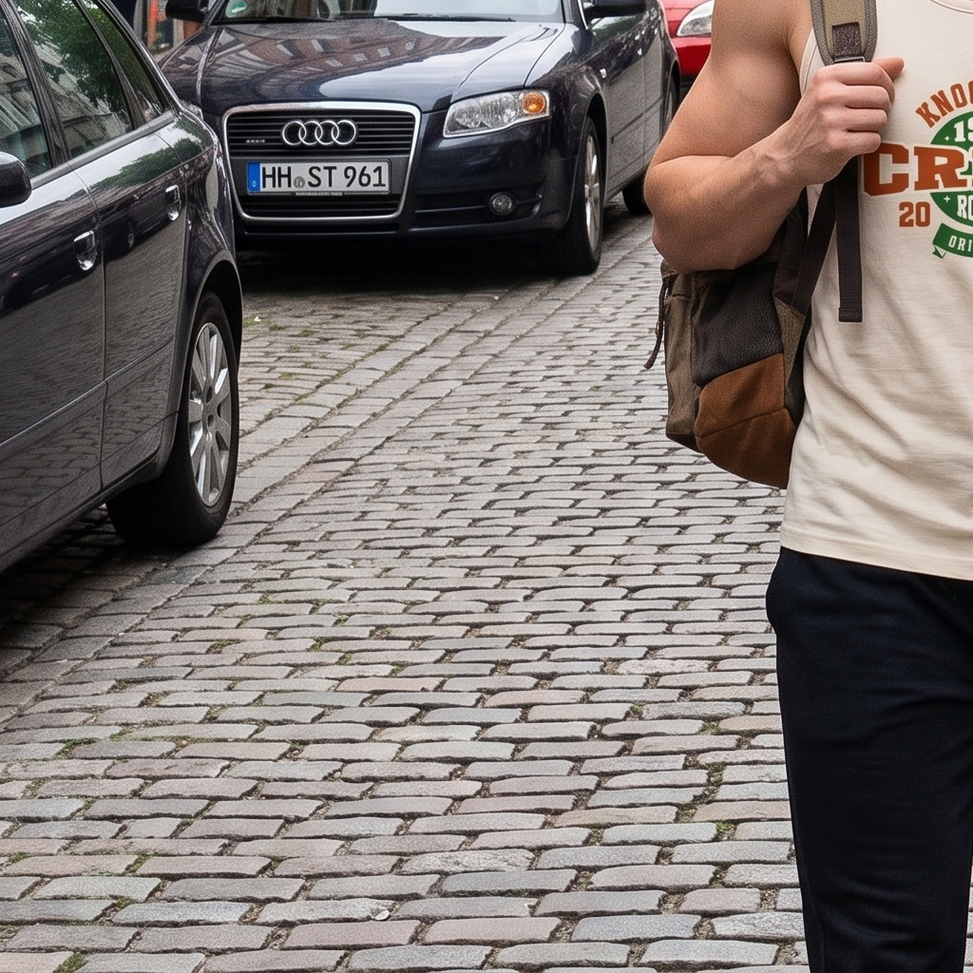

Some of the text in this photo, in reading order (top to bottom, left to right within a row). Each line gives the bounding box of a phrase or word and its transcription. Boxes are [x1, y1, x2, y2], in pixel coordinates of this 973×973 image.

[262, 166, 386, 188] HH ST 961
[899, 201, 931, 227] 20
